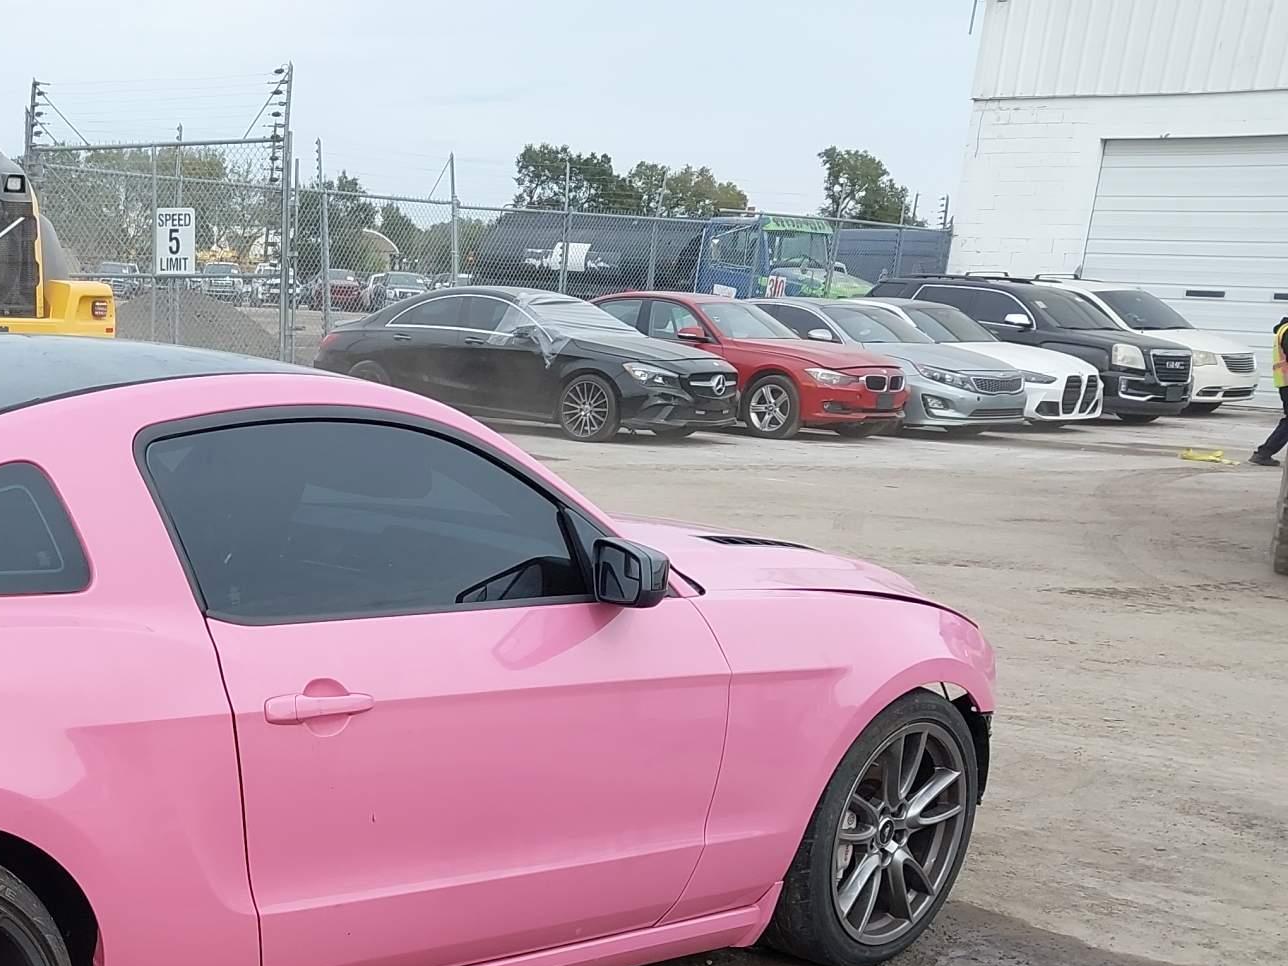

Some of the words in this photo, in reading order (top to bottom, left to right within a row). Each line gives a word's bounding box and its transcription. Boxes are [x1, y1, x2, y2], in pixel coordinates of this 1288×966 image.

[158, 213, 191, 227] SPEED
[169, 228, 180, 255] 5
[160, 257, 189, 271] LIMIT
